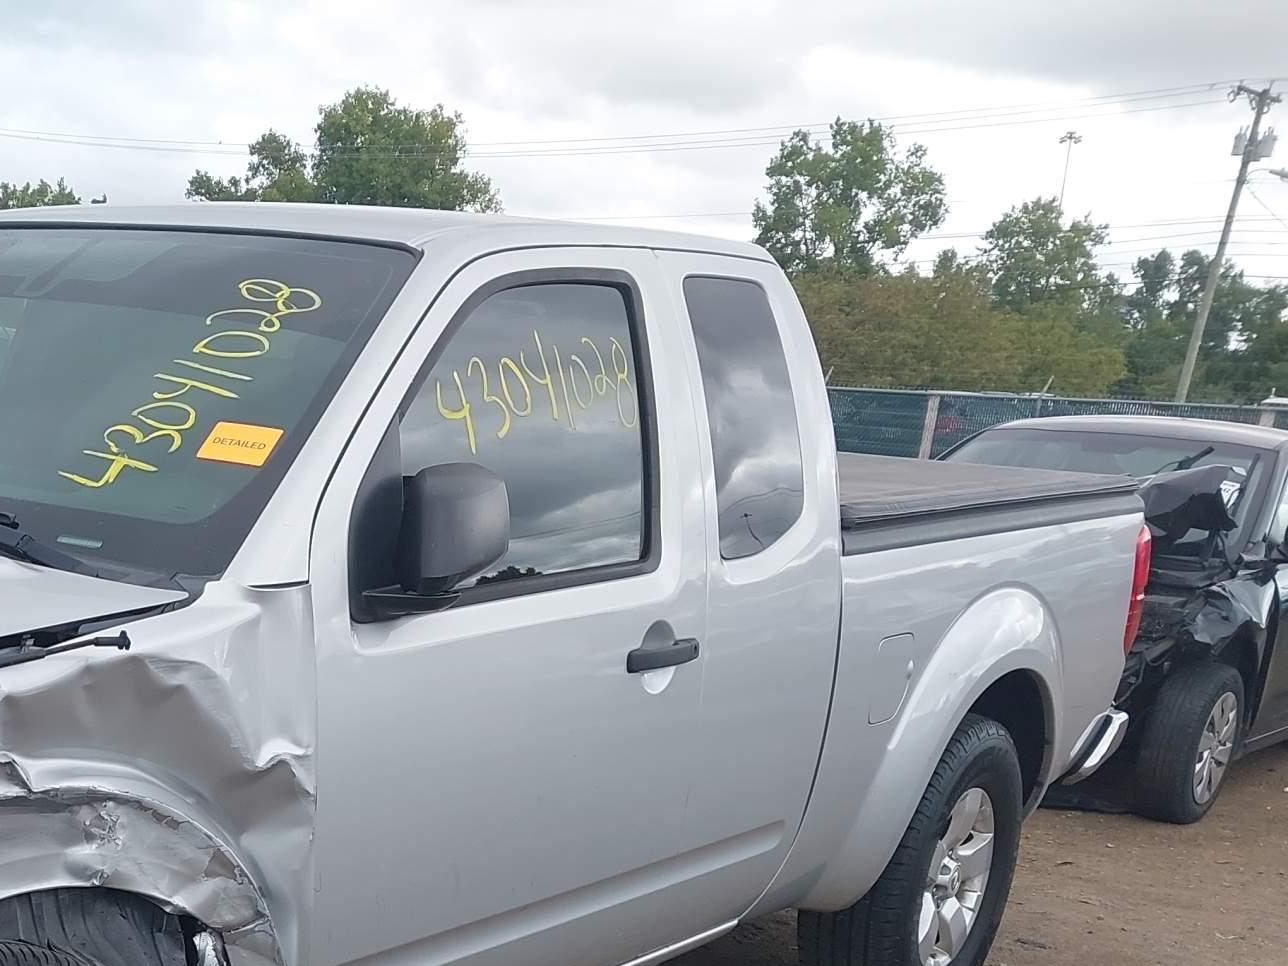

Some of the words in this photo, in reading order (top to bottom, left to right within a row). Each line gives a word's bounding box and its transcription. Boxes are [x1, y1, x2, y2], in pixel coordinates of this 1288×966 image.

[58, 279, 322, 488] 43041028
[212, 436, 267, 450] DETAILED
[436, 329, 638, 455] 43041028
